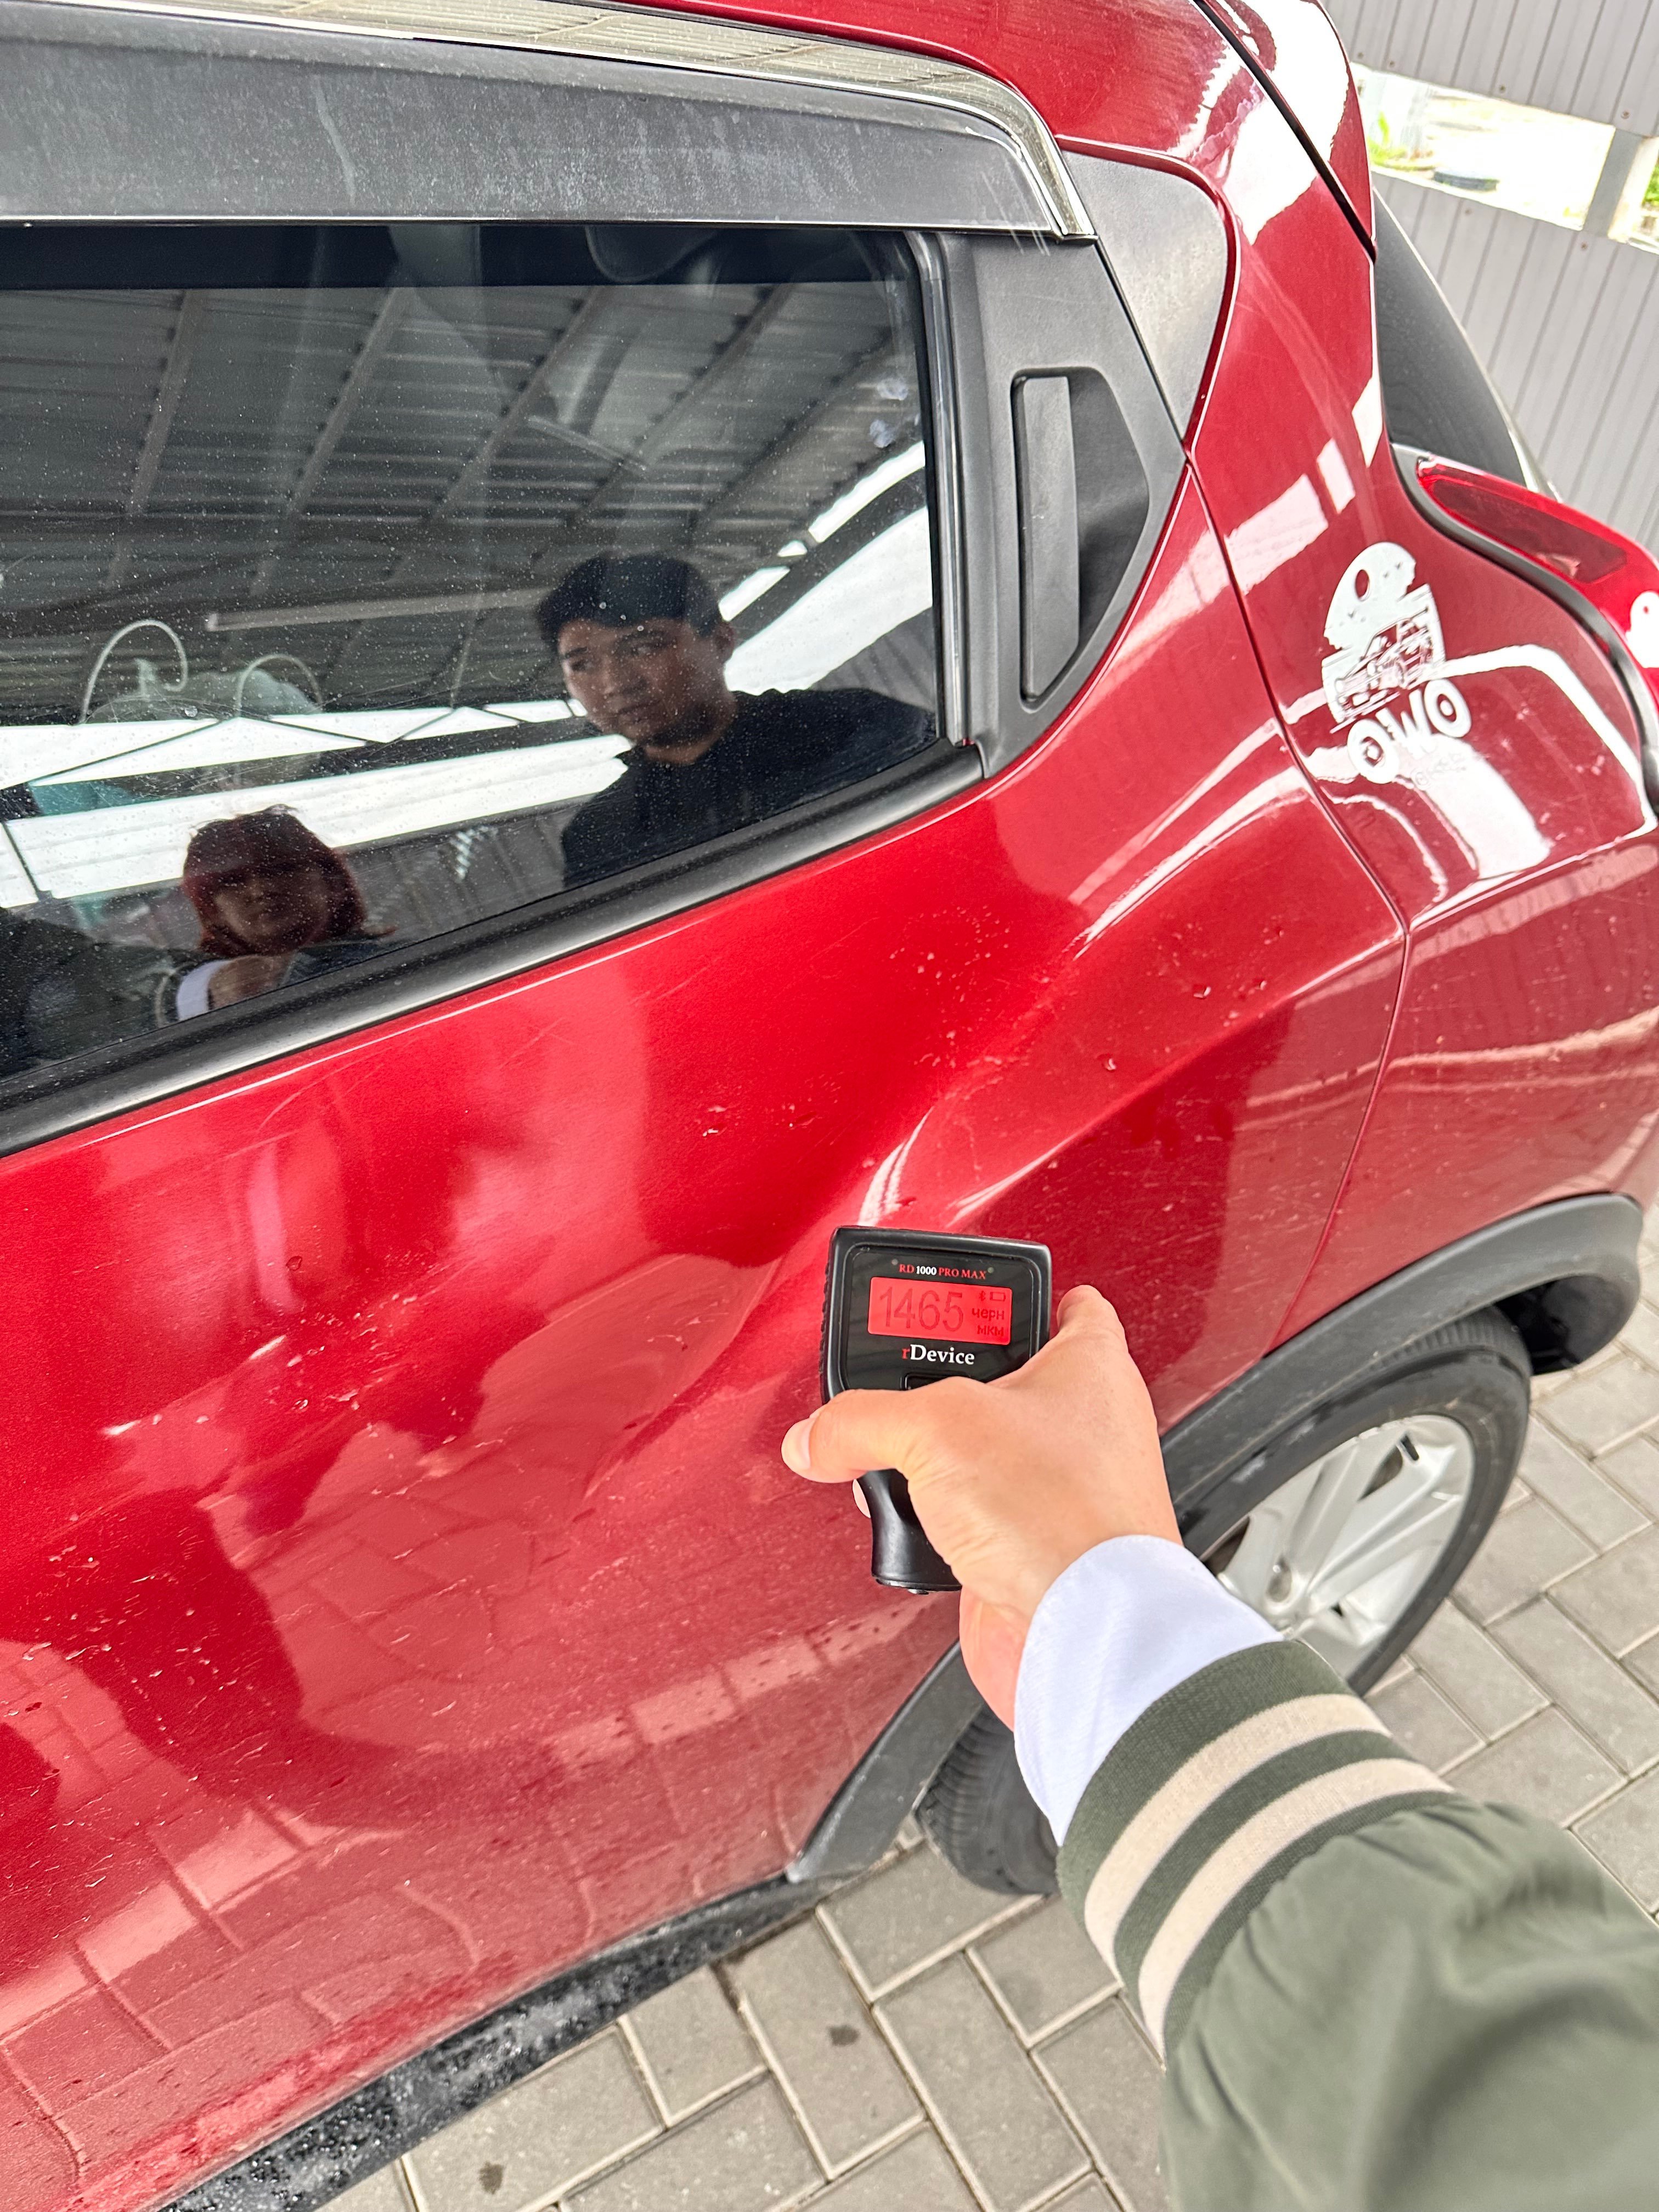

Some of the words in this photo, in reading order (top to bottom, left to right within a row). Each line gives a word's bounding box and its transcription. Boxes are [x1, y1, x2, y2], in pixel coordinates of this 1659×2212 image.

[899, 1263, 915, 1273] RD
[916, 1265, 937, 1276] 1000
[939, 1267, 959, 1277] PRO
[961, 1269, 986, 1280] MAX
[879, 1286, 964, 1331] 1465
[971, 1307, 1005, 1322] черн
[901, 1344, 975, 1365] rDevice
